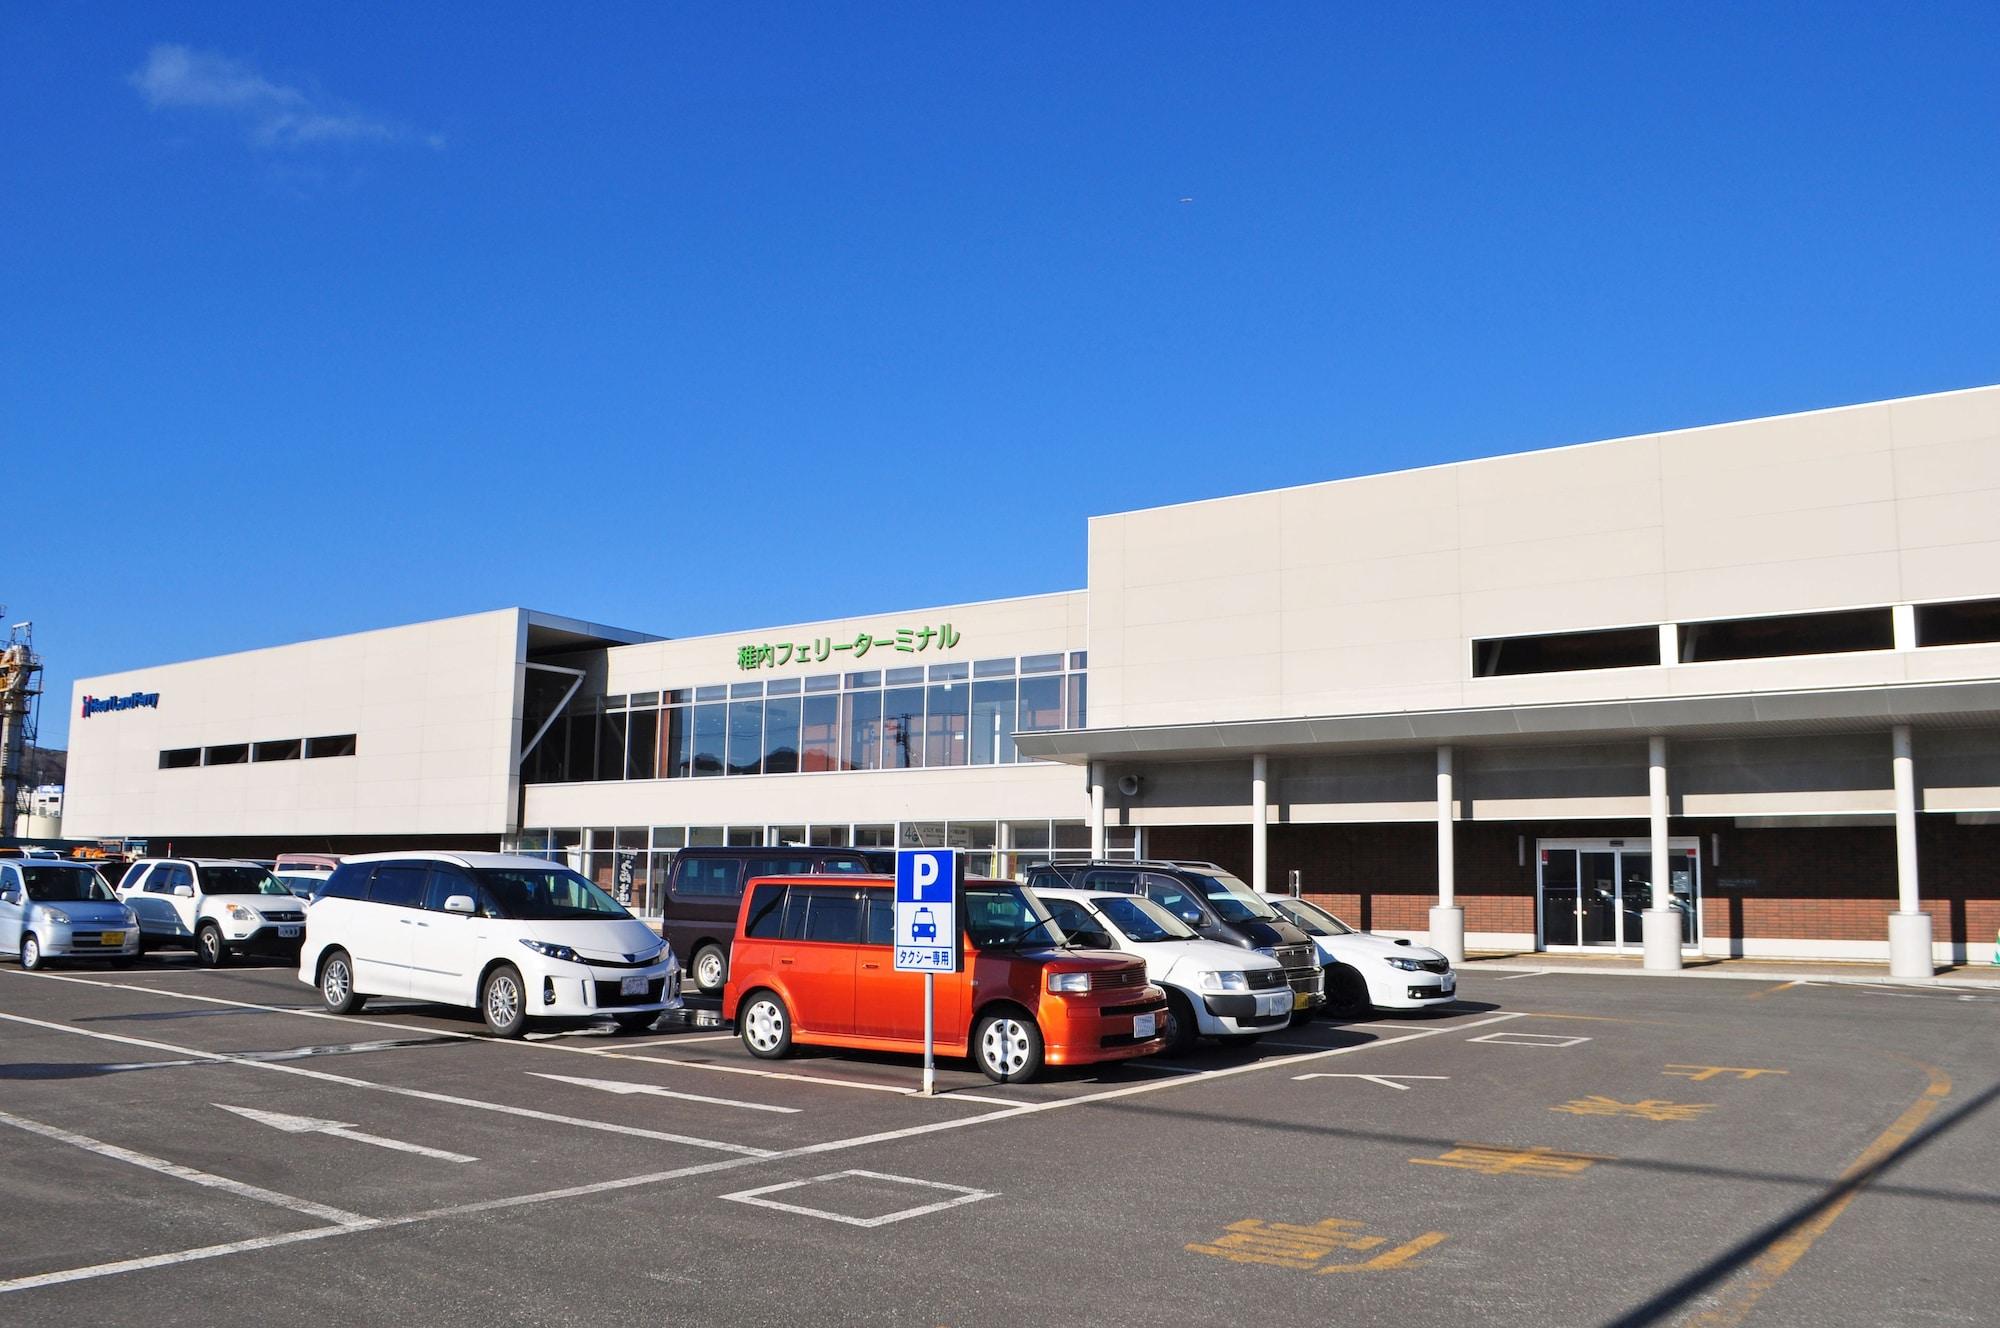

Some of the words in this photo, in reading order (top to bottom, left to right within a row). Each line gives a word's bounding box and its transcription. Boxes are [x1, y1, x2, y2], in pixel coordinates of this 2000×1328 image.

[737, 623, 961, 671] 稚内フェリーターミナル
[913, 853, 939, 900] P
[900, 950, 949, 966] タクシー専用
